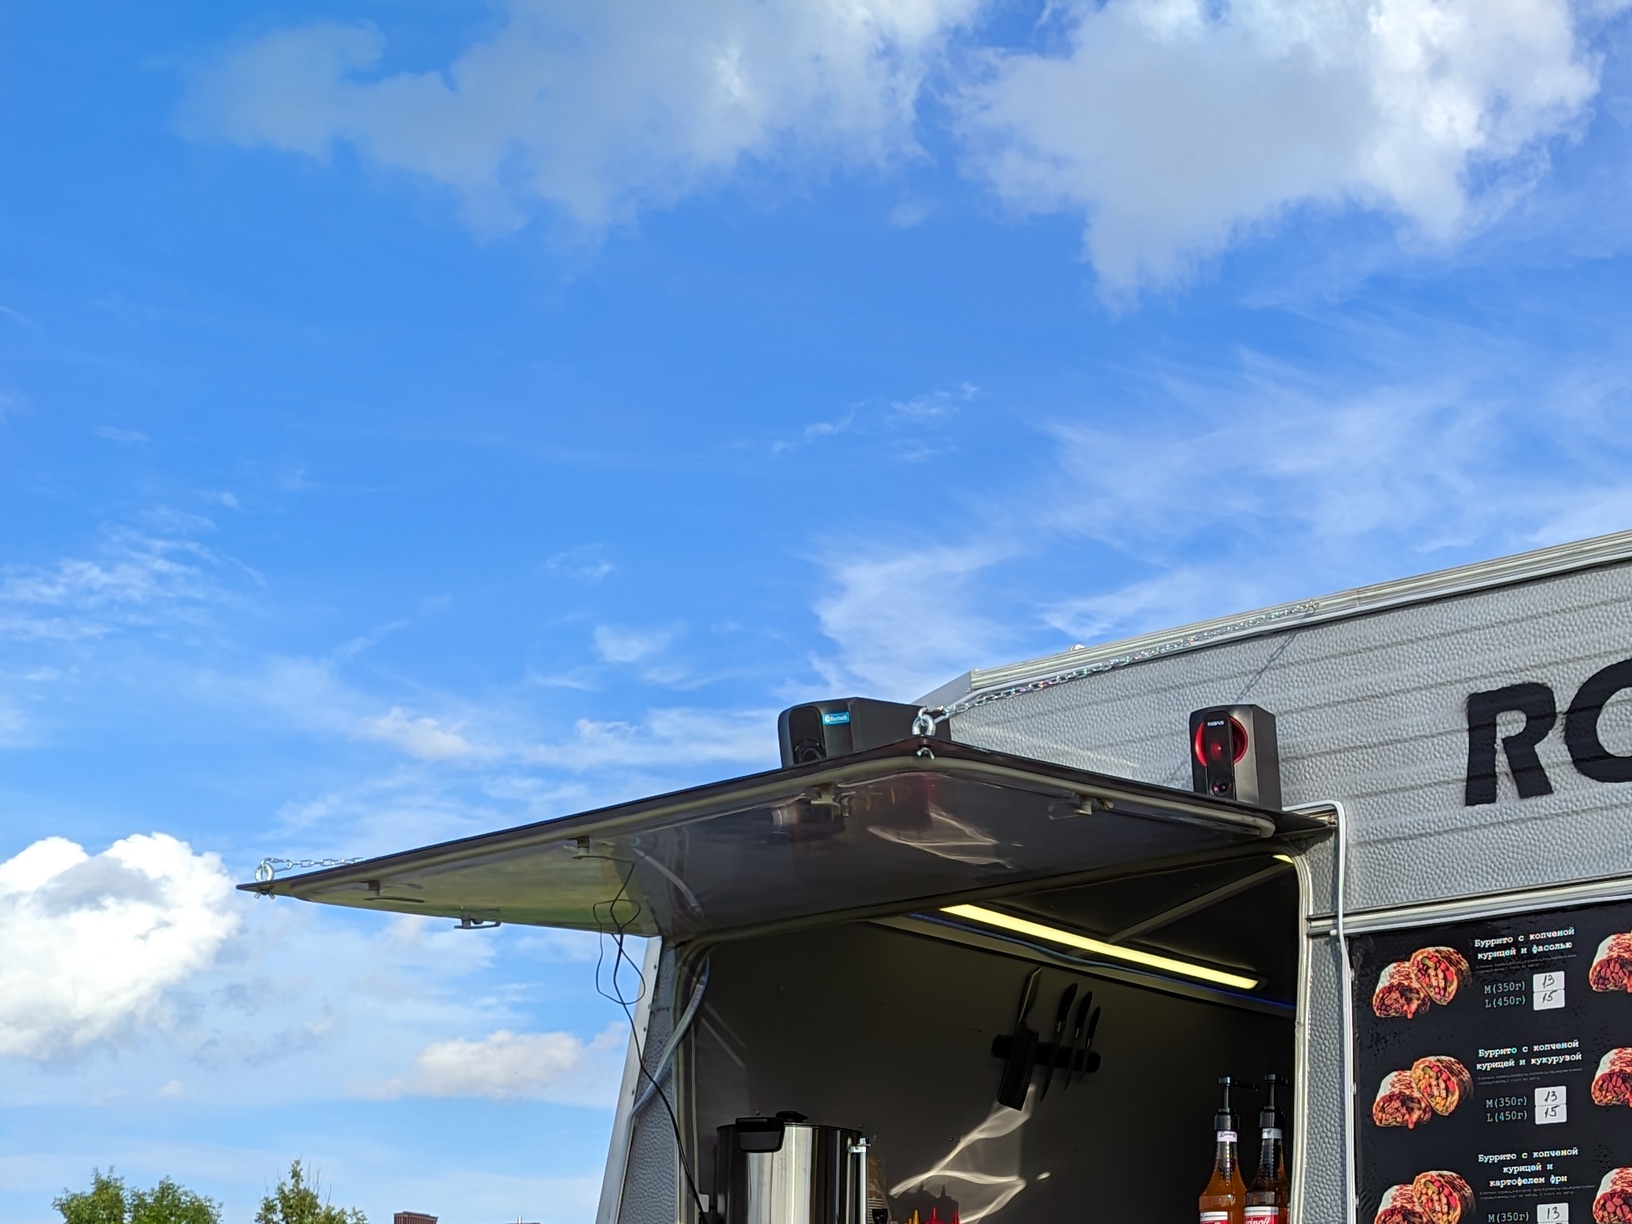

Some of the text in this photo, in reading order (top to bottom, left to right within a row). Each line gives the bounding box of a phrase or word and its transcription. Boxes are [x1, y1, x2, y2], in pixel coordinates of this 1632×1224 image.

[1474, 936, 1514, 948] Буррито
[1529, 926, 1575, 941] копченой
[1477, 947, 1517, 960] курицей
[1531, 942, 1573, 954] фасолью
[1542, 974, 1555, 987] 13
[1542, 992, 1555, 1004] 15
[1476, 1058, 1515, 1071] курицей
[1530, 1052, 1582, 1066] кукурузой
[1544, 1090, 1558, 1103] 13
[1544, 1106, 1560, 1118] 15
[1489, 1174, 1568, 1188] картофелем фри
[1546, 1206, 1561, 1220] 13
